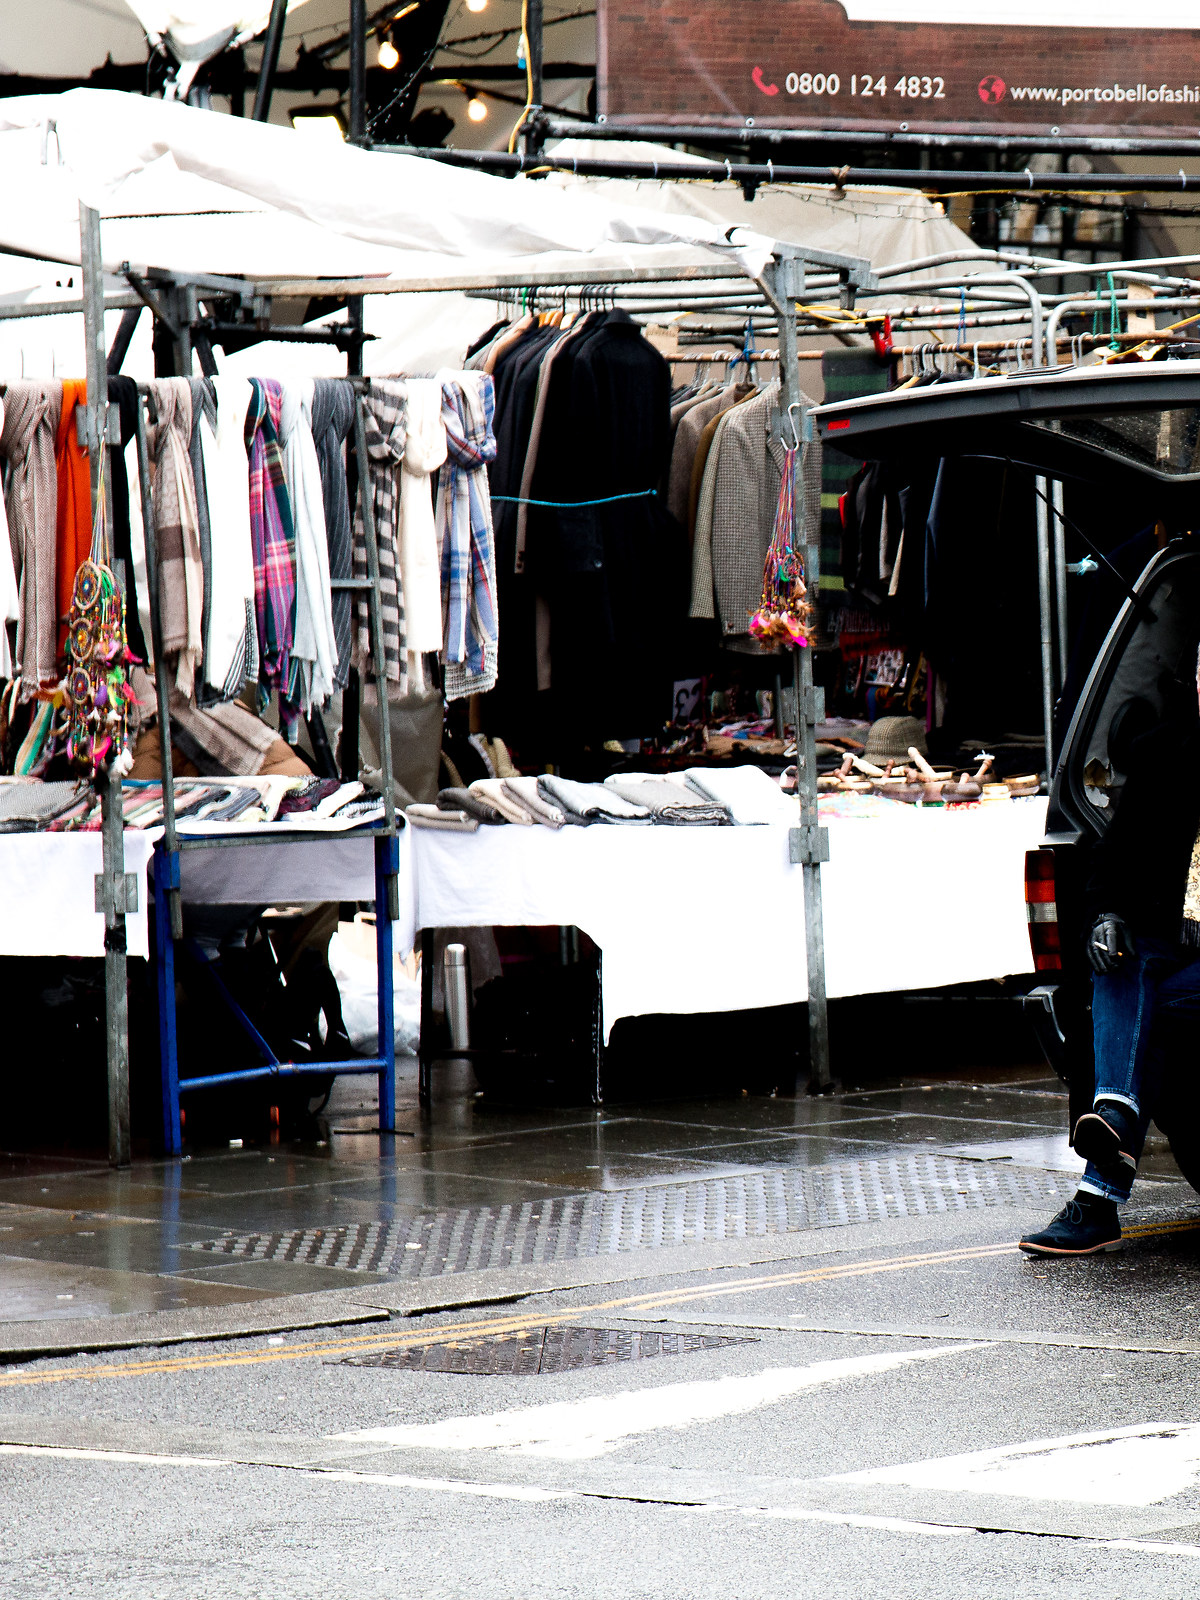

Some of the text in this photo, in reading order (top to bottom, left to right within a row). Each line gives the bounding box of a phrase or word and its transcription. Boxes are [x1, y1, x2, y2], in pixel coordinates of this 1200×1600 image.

[785, 72, 946, 99] 0800 124 4832
